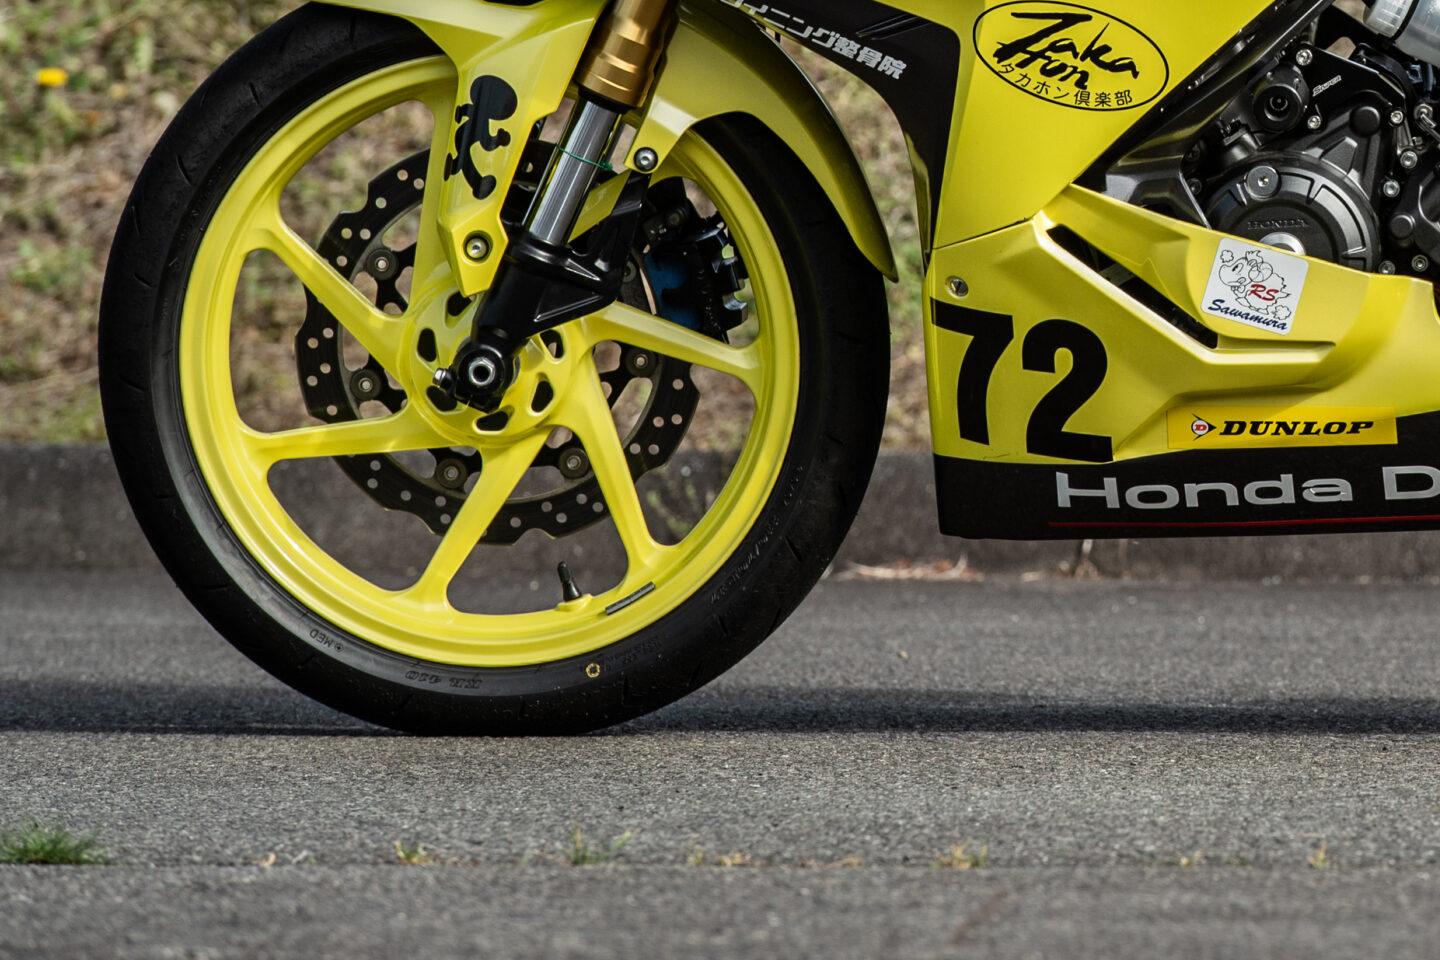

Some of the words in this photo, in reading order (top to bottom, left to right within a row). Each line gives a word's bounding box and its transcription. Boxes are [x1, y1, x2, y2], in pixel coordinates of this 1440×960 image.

[998, 62, 1133, 108] タカホン倶楽部
[1247, 218, 1310, 230] HONDA
[1248, 283, 1280, 302] RS
[1208, 299, 1288, 330] Sawamura
[930, 296, 1114, 463] 72
[1219, 420, 1375, 436] DUNLOP
[1055, 472, 1354, 509] Honda
